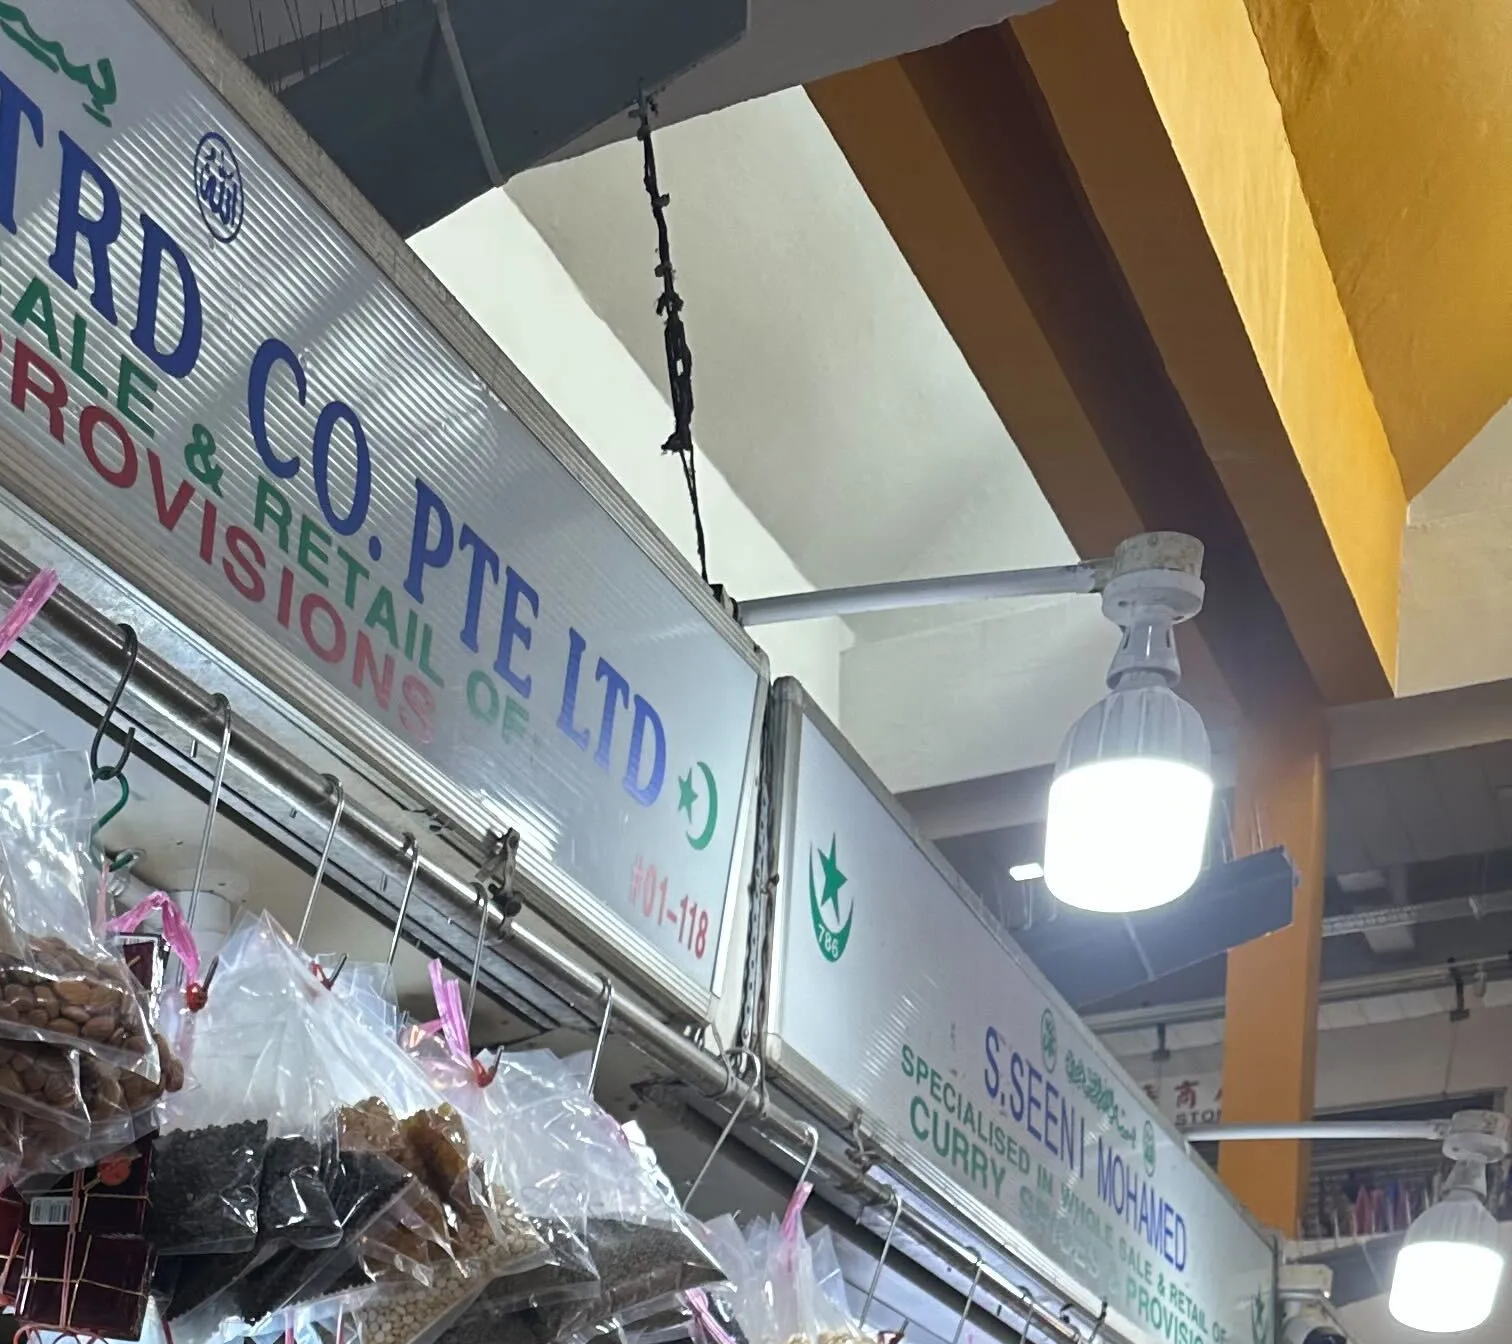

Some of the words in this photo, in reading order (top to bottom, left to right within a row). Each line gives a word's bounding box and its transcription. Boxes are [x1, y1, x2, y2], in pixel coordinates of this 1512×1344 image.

[184, 423, 223, 494] &
[253, 476, 444, 688] RETAIL
[466, 668, 530, 739] OF
[247, 338, 381, 561] CO.
[406, 477, 539, 696] PTE
[556, 625, 668, 807] LTD
[629, 852, 709, 960] #01-118
[818, 921, 839, 957] 786
[900, 1043, 1032, 1175] SPECIALISED
[1037, 1163, 1054, 1193] IN
[1119, 1235, 1152, 1284] SALE
[1156, 1271, 1166, 1296] &
[1169, 1281, 1206, 1334] RETAIL
[909, 1094, 1006, 1199] CURRY
[1096, 1135, 1187, 1273] MOHAMED
